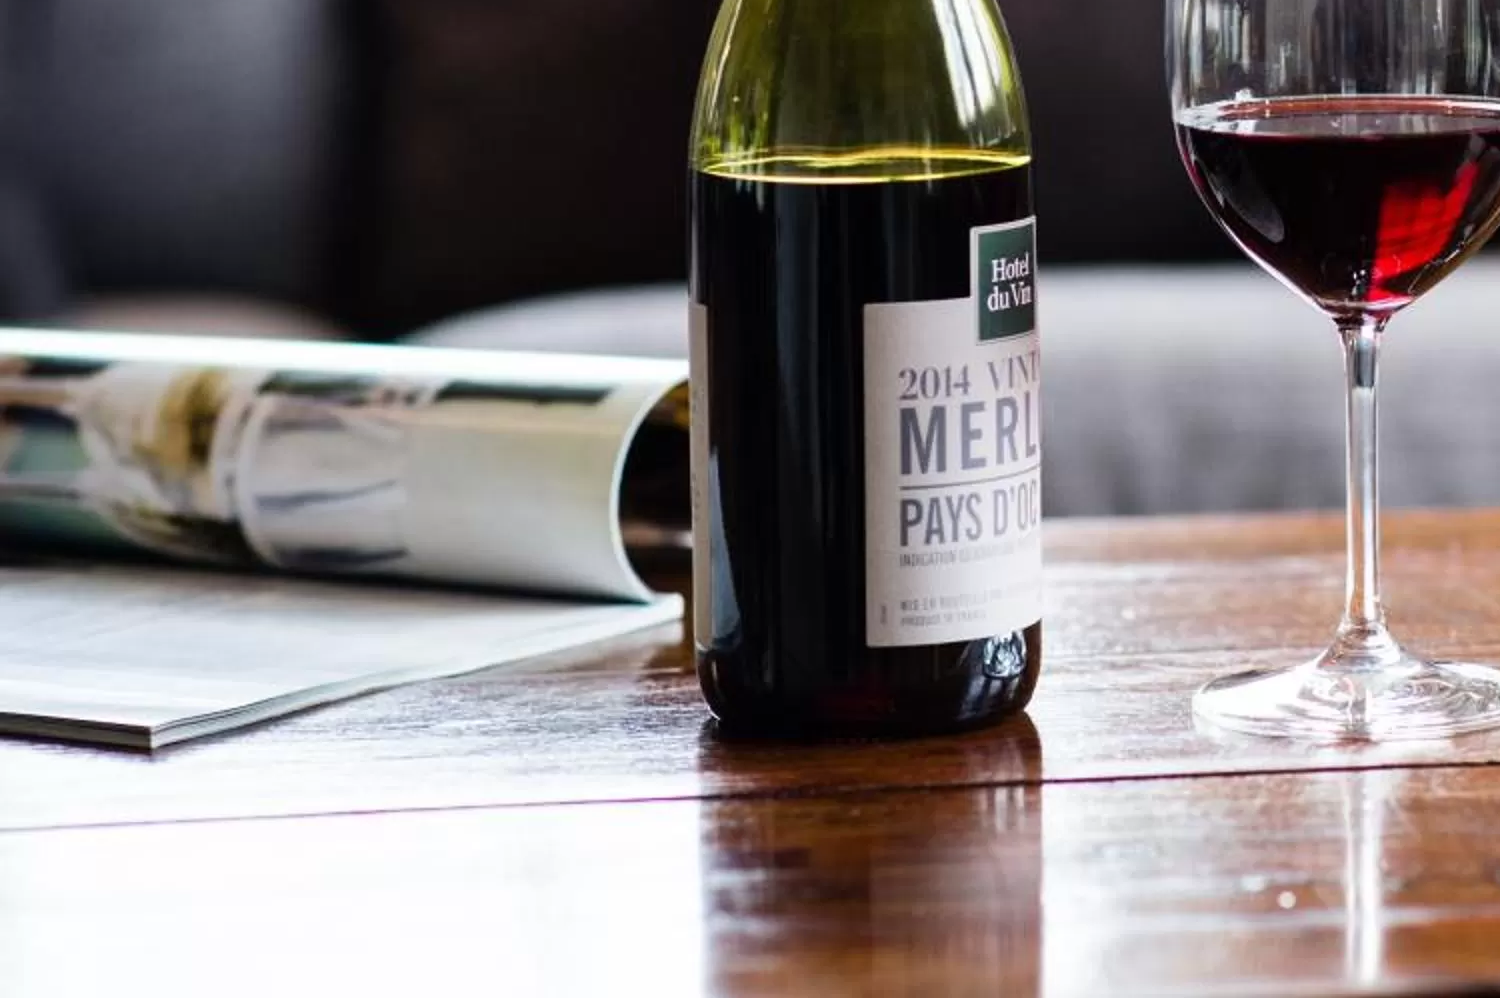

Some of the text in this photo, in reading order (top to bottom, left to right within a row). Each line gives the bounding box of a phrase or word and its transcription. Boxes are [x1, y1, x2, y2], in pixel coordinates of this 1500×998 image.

[991, 253, 1030, 282] Hotel
[987, 281, 1032, 312] du Vin
[899, 364, 969, 400] 2014
[900, 478, 1037, 547] PAYS D'OC
